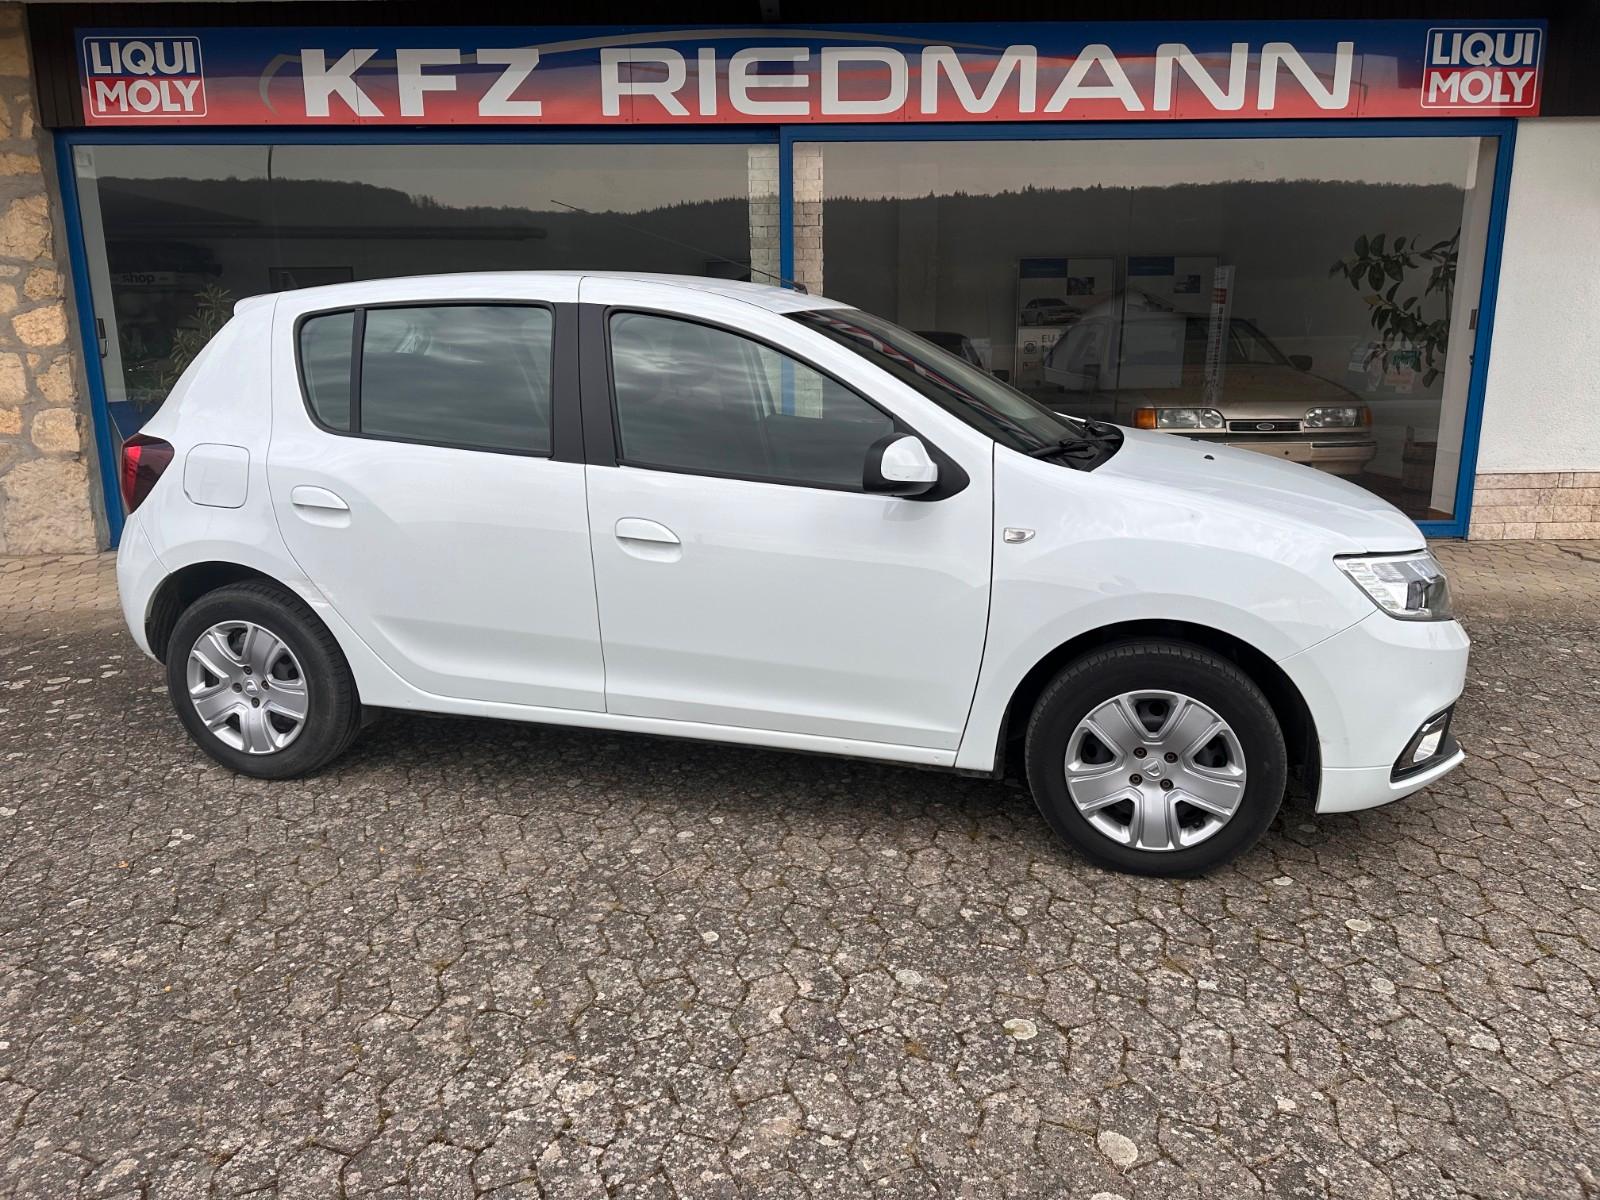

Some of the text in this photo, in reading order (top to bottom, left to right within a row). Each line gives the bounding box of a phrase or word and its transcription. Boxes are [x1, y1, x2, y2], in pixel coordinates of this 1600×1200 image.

[91, 41, 195, 76] LIQUI
[1431, 32, 1536, 67] LIQUI
[99, 79, 201, 113] MOLY
[300, 42, 1354, 117] KFZ RIEDMANN
[1428, 70, 1535, 104] MOLY
